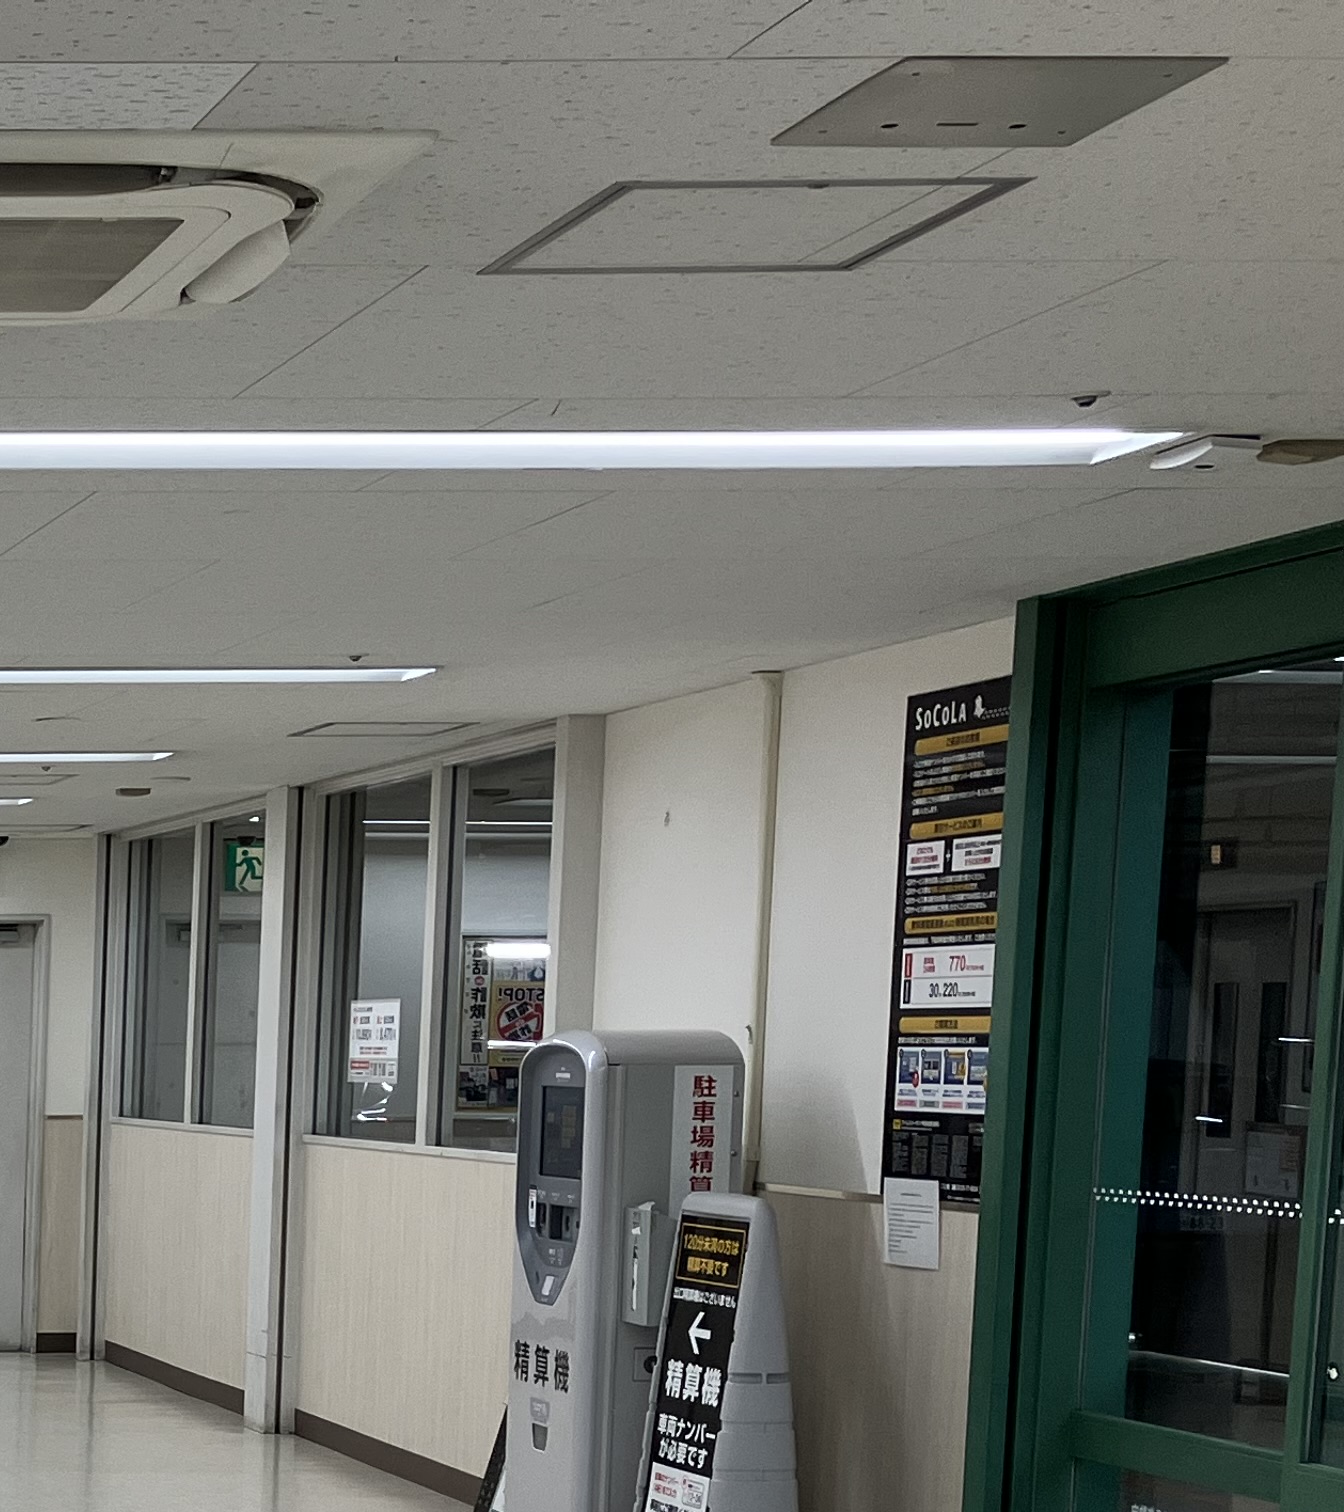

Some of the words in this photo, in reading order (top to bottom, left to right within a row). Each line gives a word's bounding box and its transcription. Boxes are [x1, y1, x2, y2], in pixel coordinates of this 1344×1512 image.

[514, 1339, 570, 1394] 精算機
[665, 1358, 722, 1408] 精算機
[657, 1412, 716, 1444] 車両ナンバー
[657, 1437, 709, 1469] が必要です
